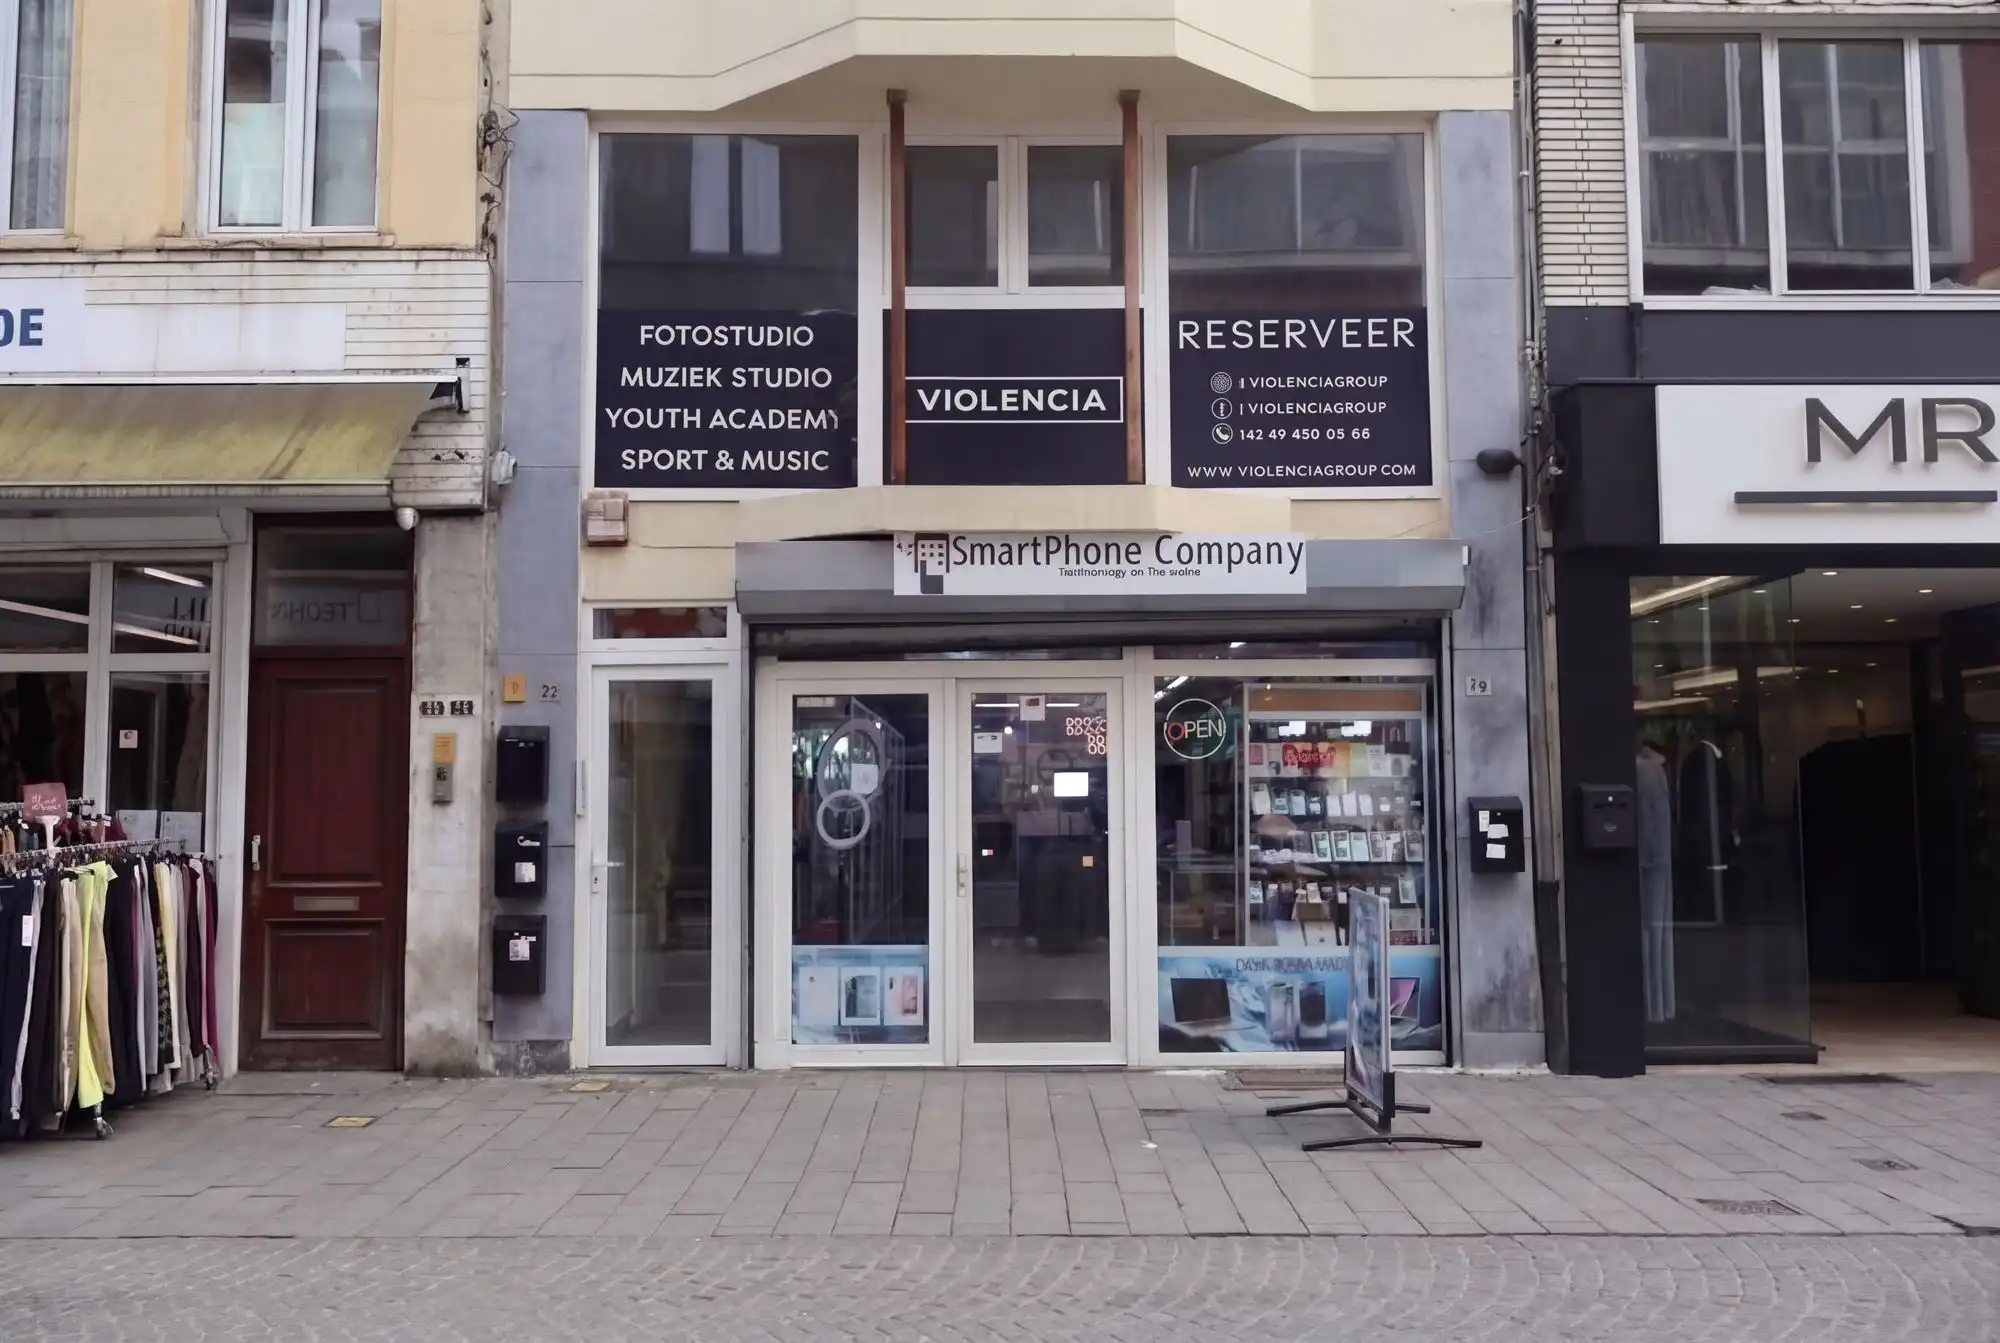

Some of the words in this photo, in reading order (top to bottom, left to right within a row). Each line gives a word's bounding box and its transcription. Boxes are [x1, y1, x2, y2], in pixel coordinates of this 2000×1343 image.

[640, 325, 814, 347] FOTOSTUDIO
[1178, 318, 1416, 349] RESERVEER
[620, 367, 723, 388] MUZIEK
[731, 367, 833, 388] STUDIO
[1249, 376, 1389, 389] VIOLENCIAGROUP
[916, 388, 1107, 412] VIOLENCIA
[1248, 402, 1388, 415] VIOLENCIAGROUP
[604, 407, 701, 429] YOUTH
[708, 408, 840, 430] ACADEMY
[1239, 429, 1264, 441] 142
[1268, 429, 1287, 441] 49
[1291, 428, 1320, 441] 450
[1326, 428, 1345, 441] 05
[1351, 428, 1371, 440] 66
[1805, 397, 2000, 463] MR
[621, 448, 708, 471] SPORT
[715, 450, 735, 471] &
[741, 449, 830, 471] MUSIC
[952, 535, 1142, 566] SmartPhone
[1154, 535, 1304, 575] Company
[1167, 719, 1223, 741] OPEN
